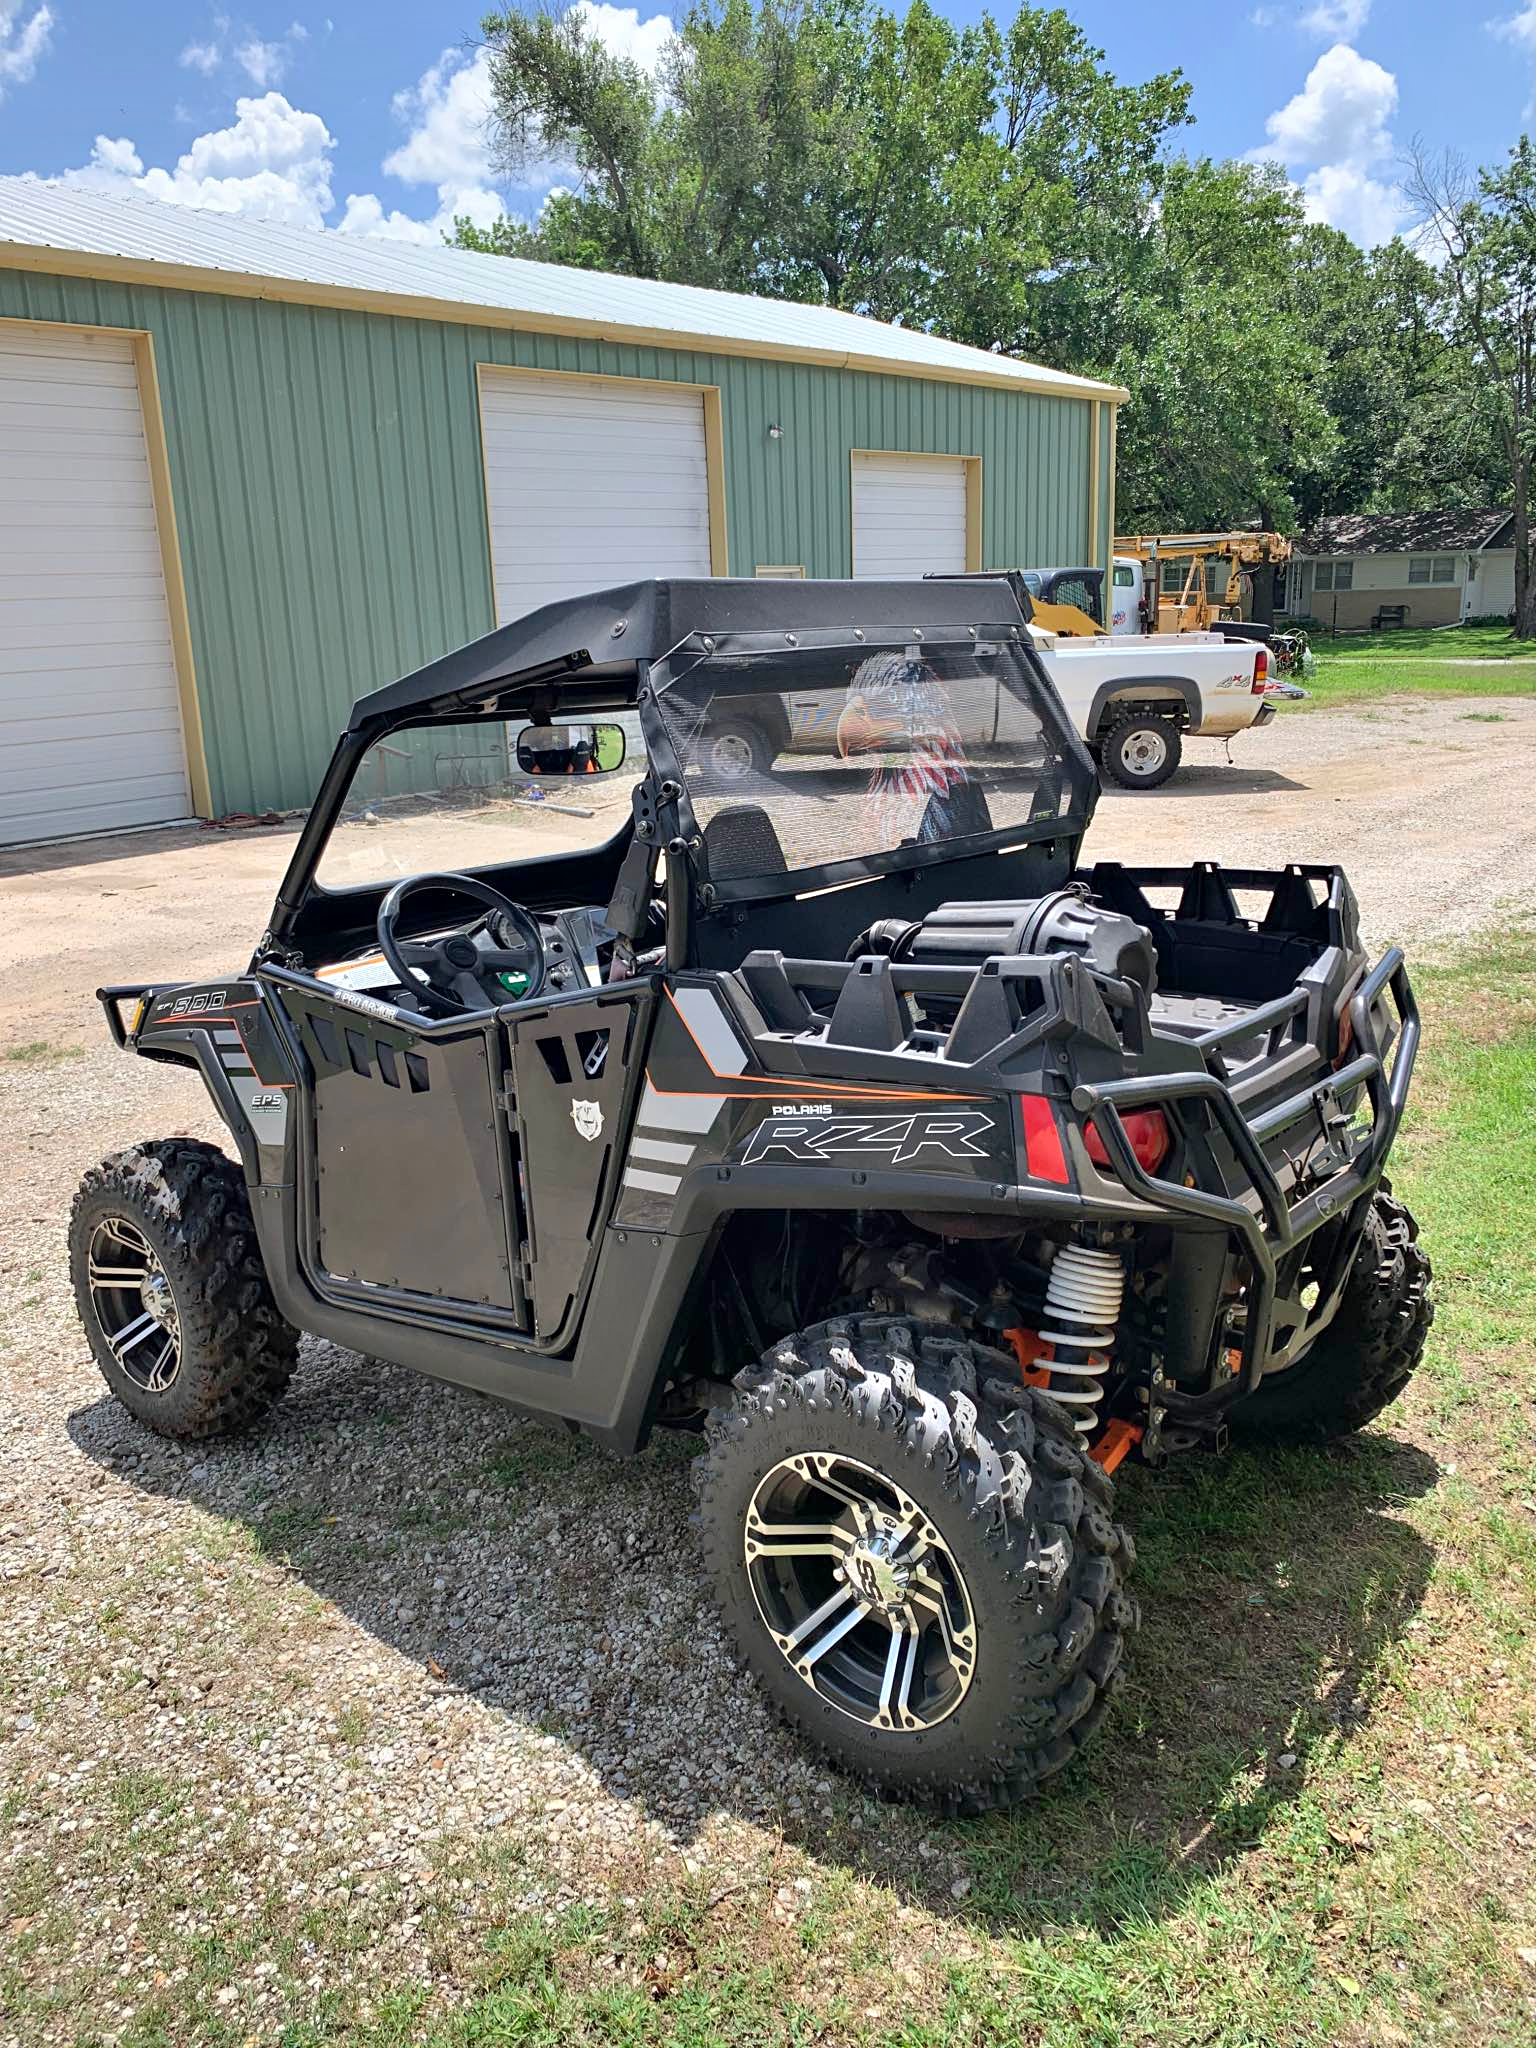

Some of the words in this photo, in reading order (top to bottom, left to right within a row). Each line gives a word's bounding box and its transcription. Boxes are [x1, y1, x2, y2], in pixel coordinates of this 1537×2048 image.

[170, 991, 227, 1016] 800
[341, 993, 362, 1008] PRO
[252, 1094, 282, 1105] EPS
[772, 1104, 833, 1116] POLARIS
[740, 1112, 996, 1166] RZR
